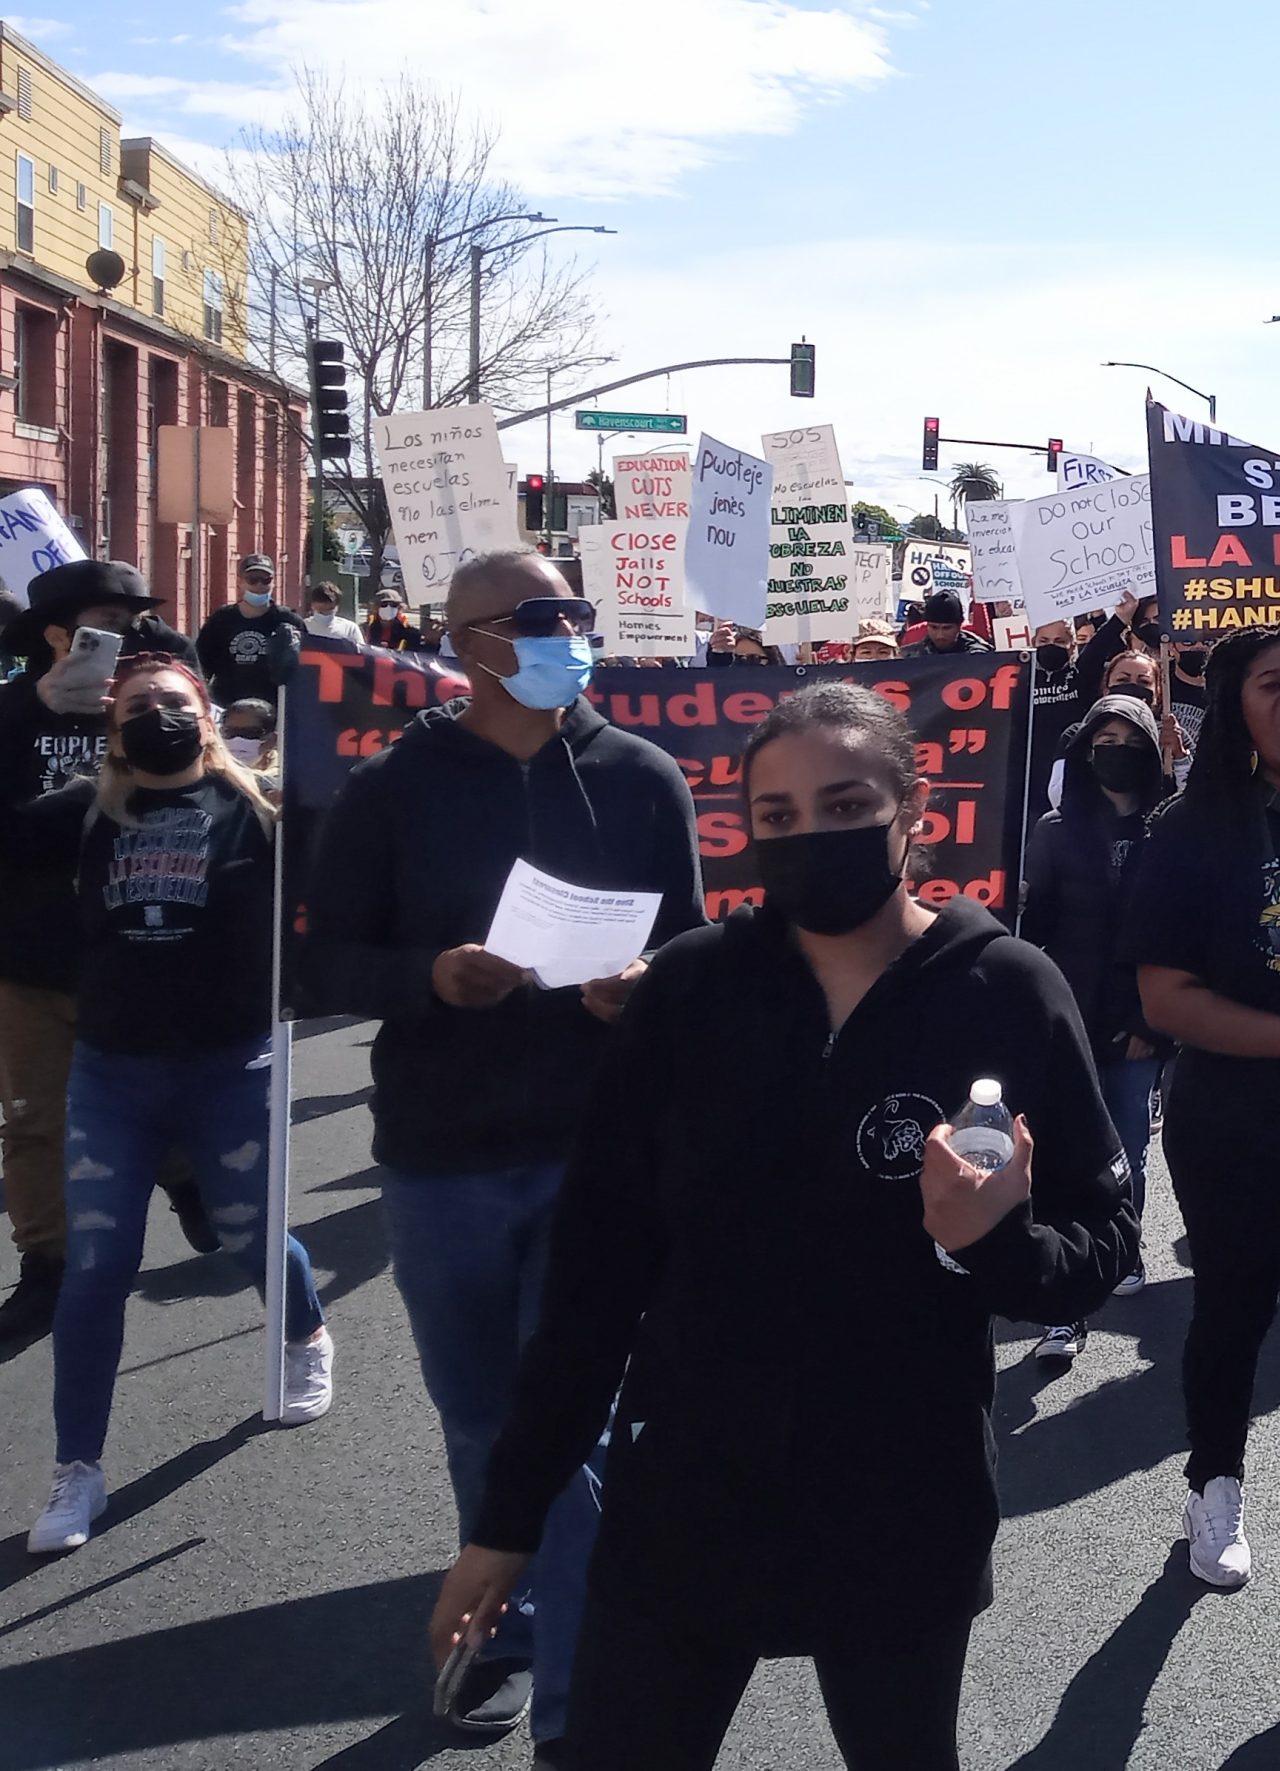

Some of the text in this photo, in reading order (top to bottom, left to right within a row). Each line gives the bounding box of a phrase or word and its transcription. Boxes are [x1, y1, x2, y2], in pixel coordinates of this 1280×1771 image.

[385, 426, 422, 450] Los
[771, 428, 821, 448] SOS
[1163, 411, 1253, 447] MI
[388, 452, 465, 473] necesitan
[617, 456, 687, 472] EDUCATION
[393, 469, 470, 495] escuelas
[631, 477, 672, 497] CUTS
[430, 500, 455, 519] las
[624, 502, 689, 519] NEVER
[771, 504, 847, 525] LIMINEN
[990, 512, 1008, 524] mej
[1038, 502, 1065, 525] DO
[1071, 498, 1092, 514] not
[706, 524, 736, 548] nou
[788, 527, 811, 541] LA
[770, 541, 846, 558] OBREZA
[1170, 534, 1252, 568] LA
[854, 550, 884, 569] TECT
[790, 562, 814, 577] NO
[1136, 571, 1154, 581] OPE
[616, 573, 670, 591] NOT
[767, 574, 848, 593] NUESTRAS
[618, 590, 673, 607] Schools
[619, 620, 661, 631] Homies
[619, 631, 688, 643] Empowerment
[300, 651, 1021, 726] The tudes of
[1033, 683, 1069, 696] omies
[1034, 689, 1078, 705] owerment
[696, 801, 976, 857] Sol
